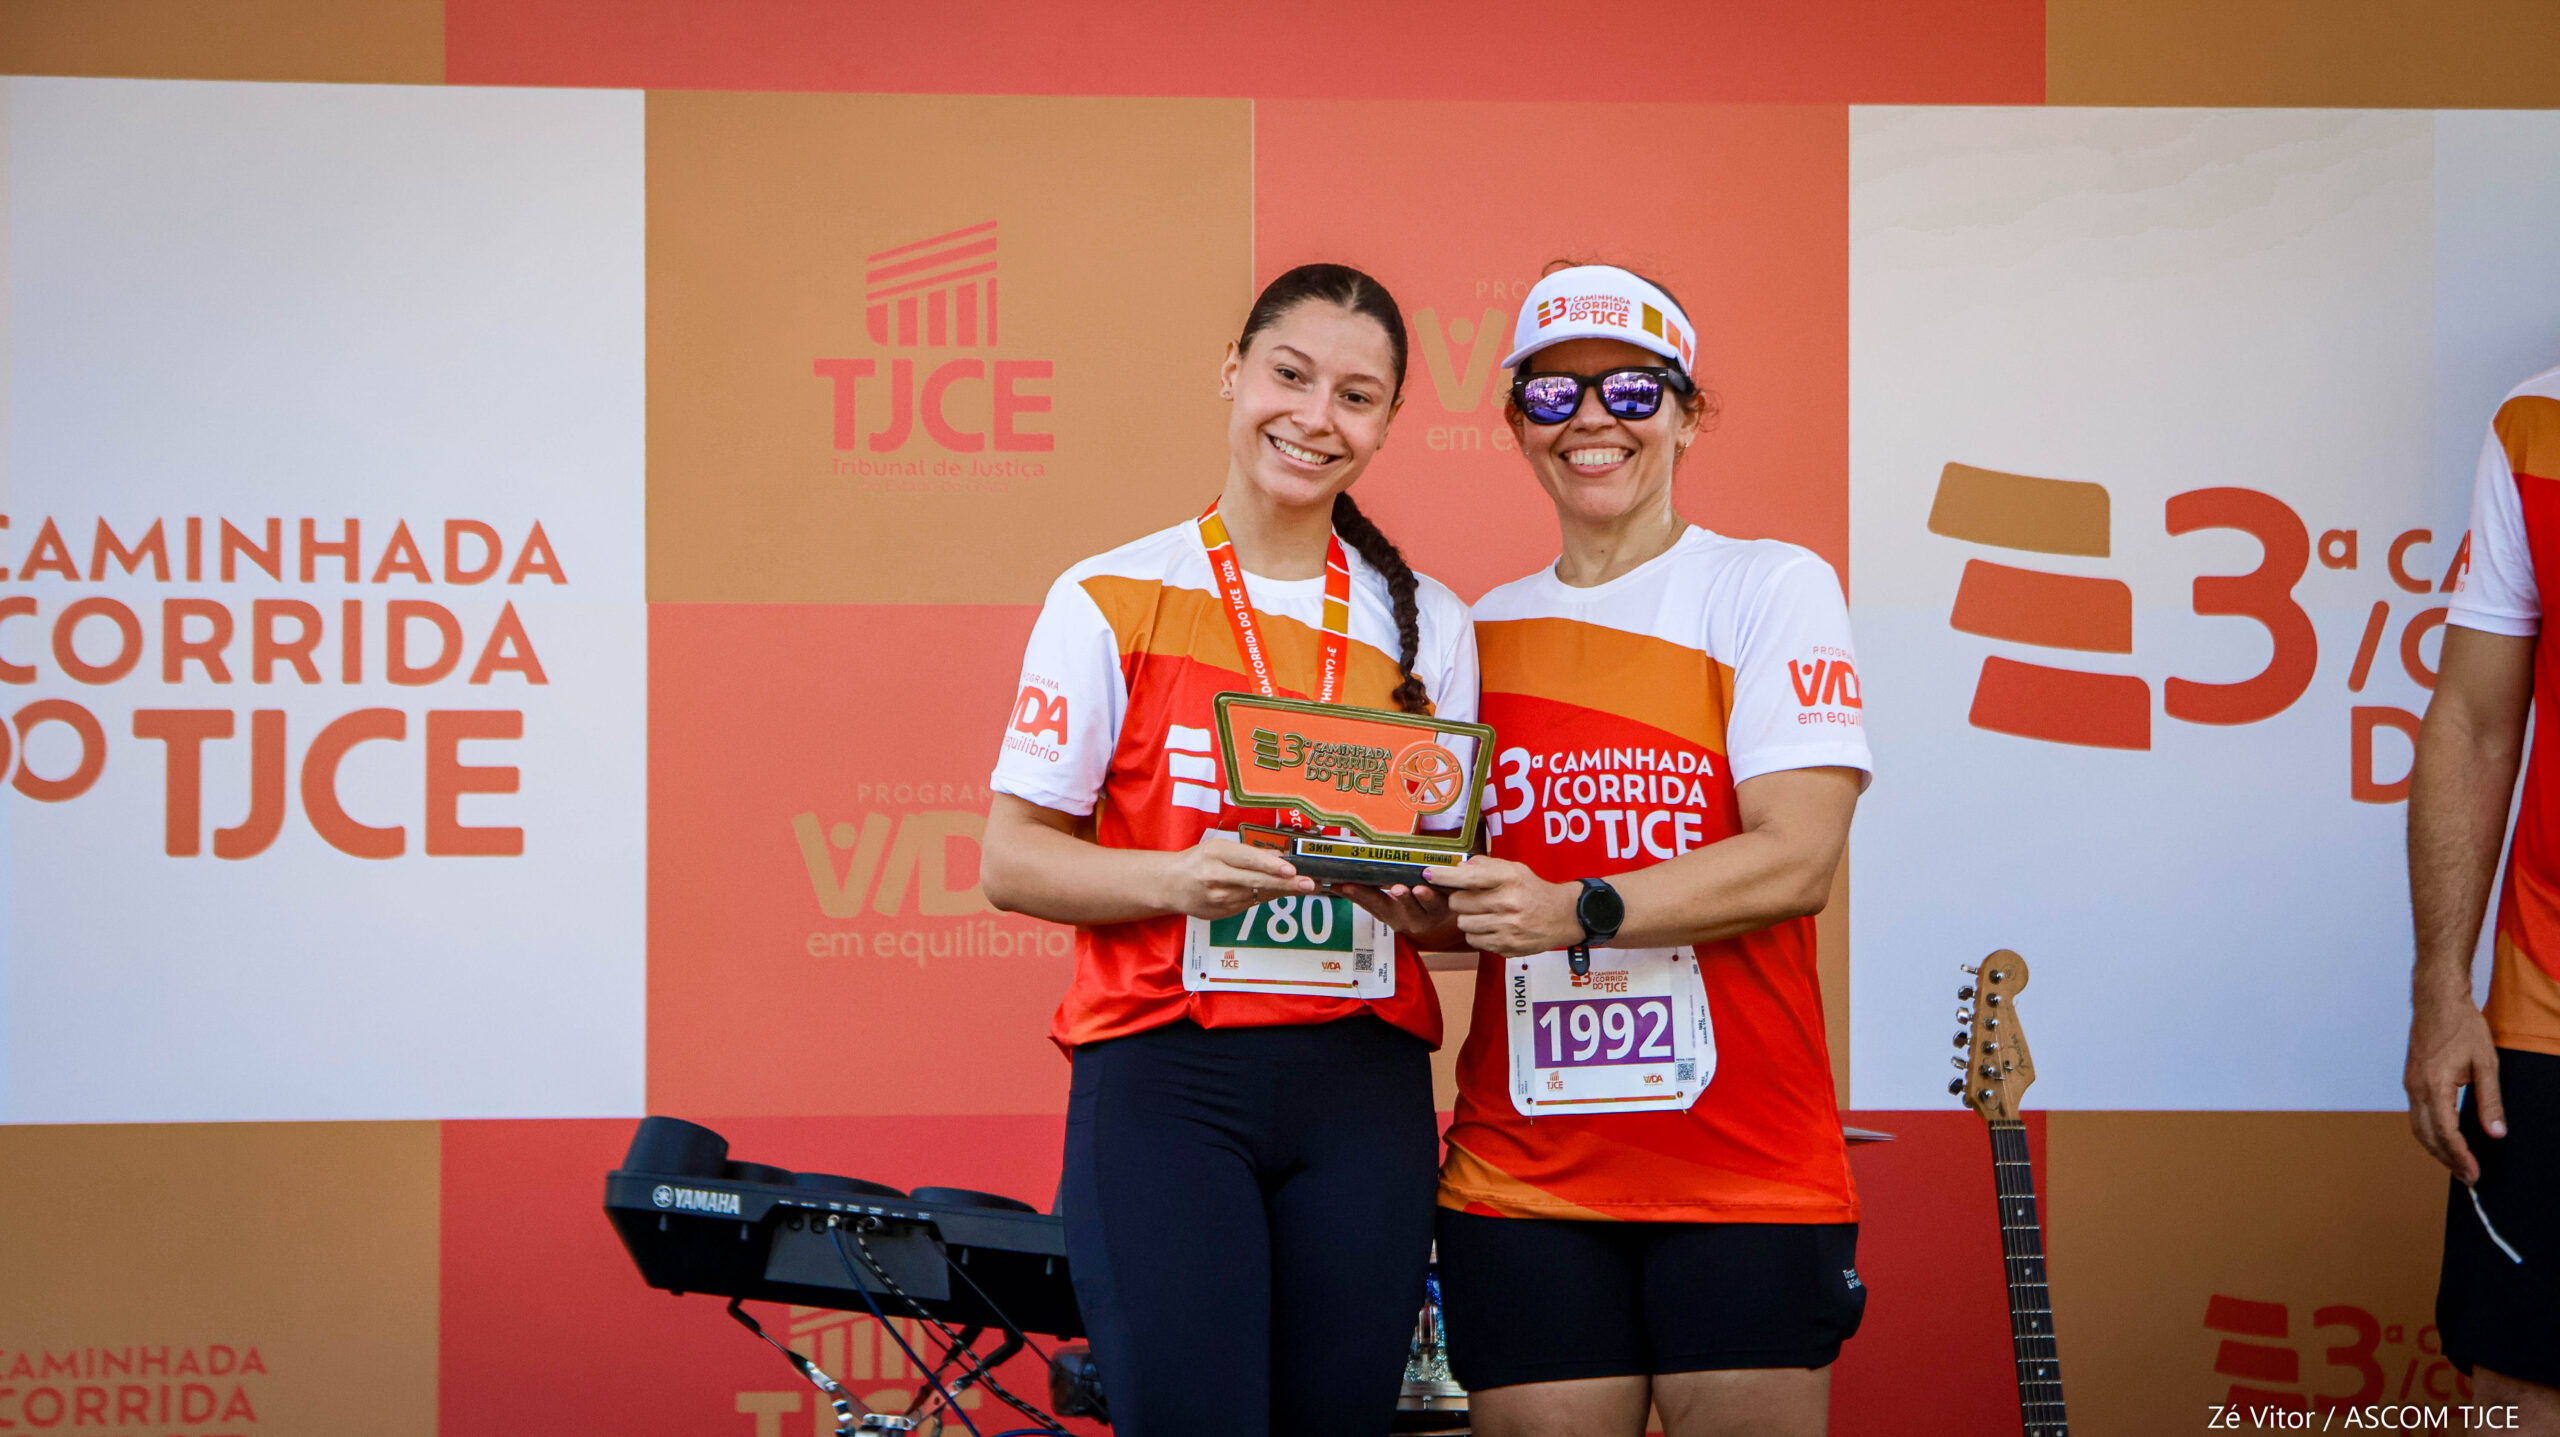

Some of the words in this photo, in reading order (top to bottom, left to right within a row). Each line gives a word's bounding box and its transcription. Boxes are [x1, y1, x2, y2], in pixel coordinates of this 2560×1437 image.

[1573, 294, 1631, 305] CAMINHADA
[1569, 310, 1588, 322] DO
[1590, 310, 1628, 328] TJCE
[813, 358, 1055, 453] TJCE
[1427, 425, 1481, 451] em
[831, 457, 925, 477] Tribunal
[933, 459, 961, 477] de
[969, 457, 1047, 481] Justiça
[0, 514, 569, 585] AMINHADA
[1221, 560, 1238, 583] 2026
[1229, 588, 1246, 611] TJCE
[1237, 611, 1252, 628] DO
[1787, 658, 1863, 709] VID
[1798, 712, 1823, 725] em
[1312, 740, 1393, 760] CAMINHADA
[1549, 747, 1714, 777] CAMINHADA
[133, 707, 524, 860] TJCE
[1305, 764, 1332, 782] DO
[1332, 768, 1386, 795] TJCE
[1544, 809, 1592, 845] DO
[1595, 810, 1704, 860] TJCE
[1308, 842, 1334, 854] 3KM
[1368, 847, 1411, 861] LUGAR
[806, 931, 864, 958] em
[873, 920, 1071, 968] equilíbrio
[1221, 959, 1240, 969] TJCE
[1514, 975, 1527, 1016] 10KM
[1592, 982, 1604, 990] DO
[1604, 982, 1628, 993] TJCE
[1538, 1000, 1672, 1063] 1992
[1546, 1080, 1564, 1090] TJCE
[674, 1187, 740, 1215] YAMAHA
[0, 1345, 268, 1381] AMINHADA
